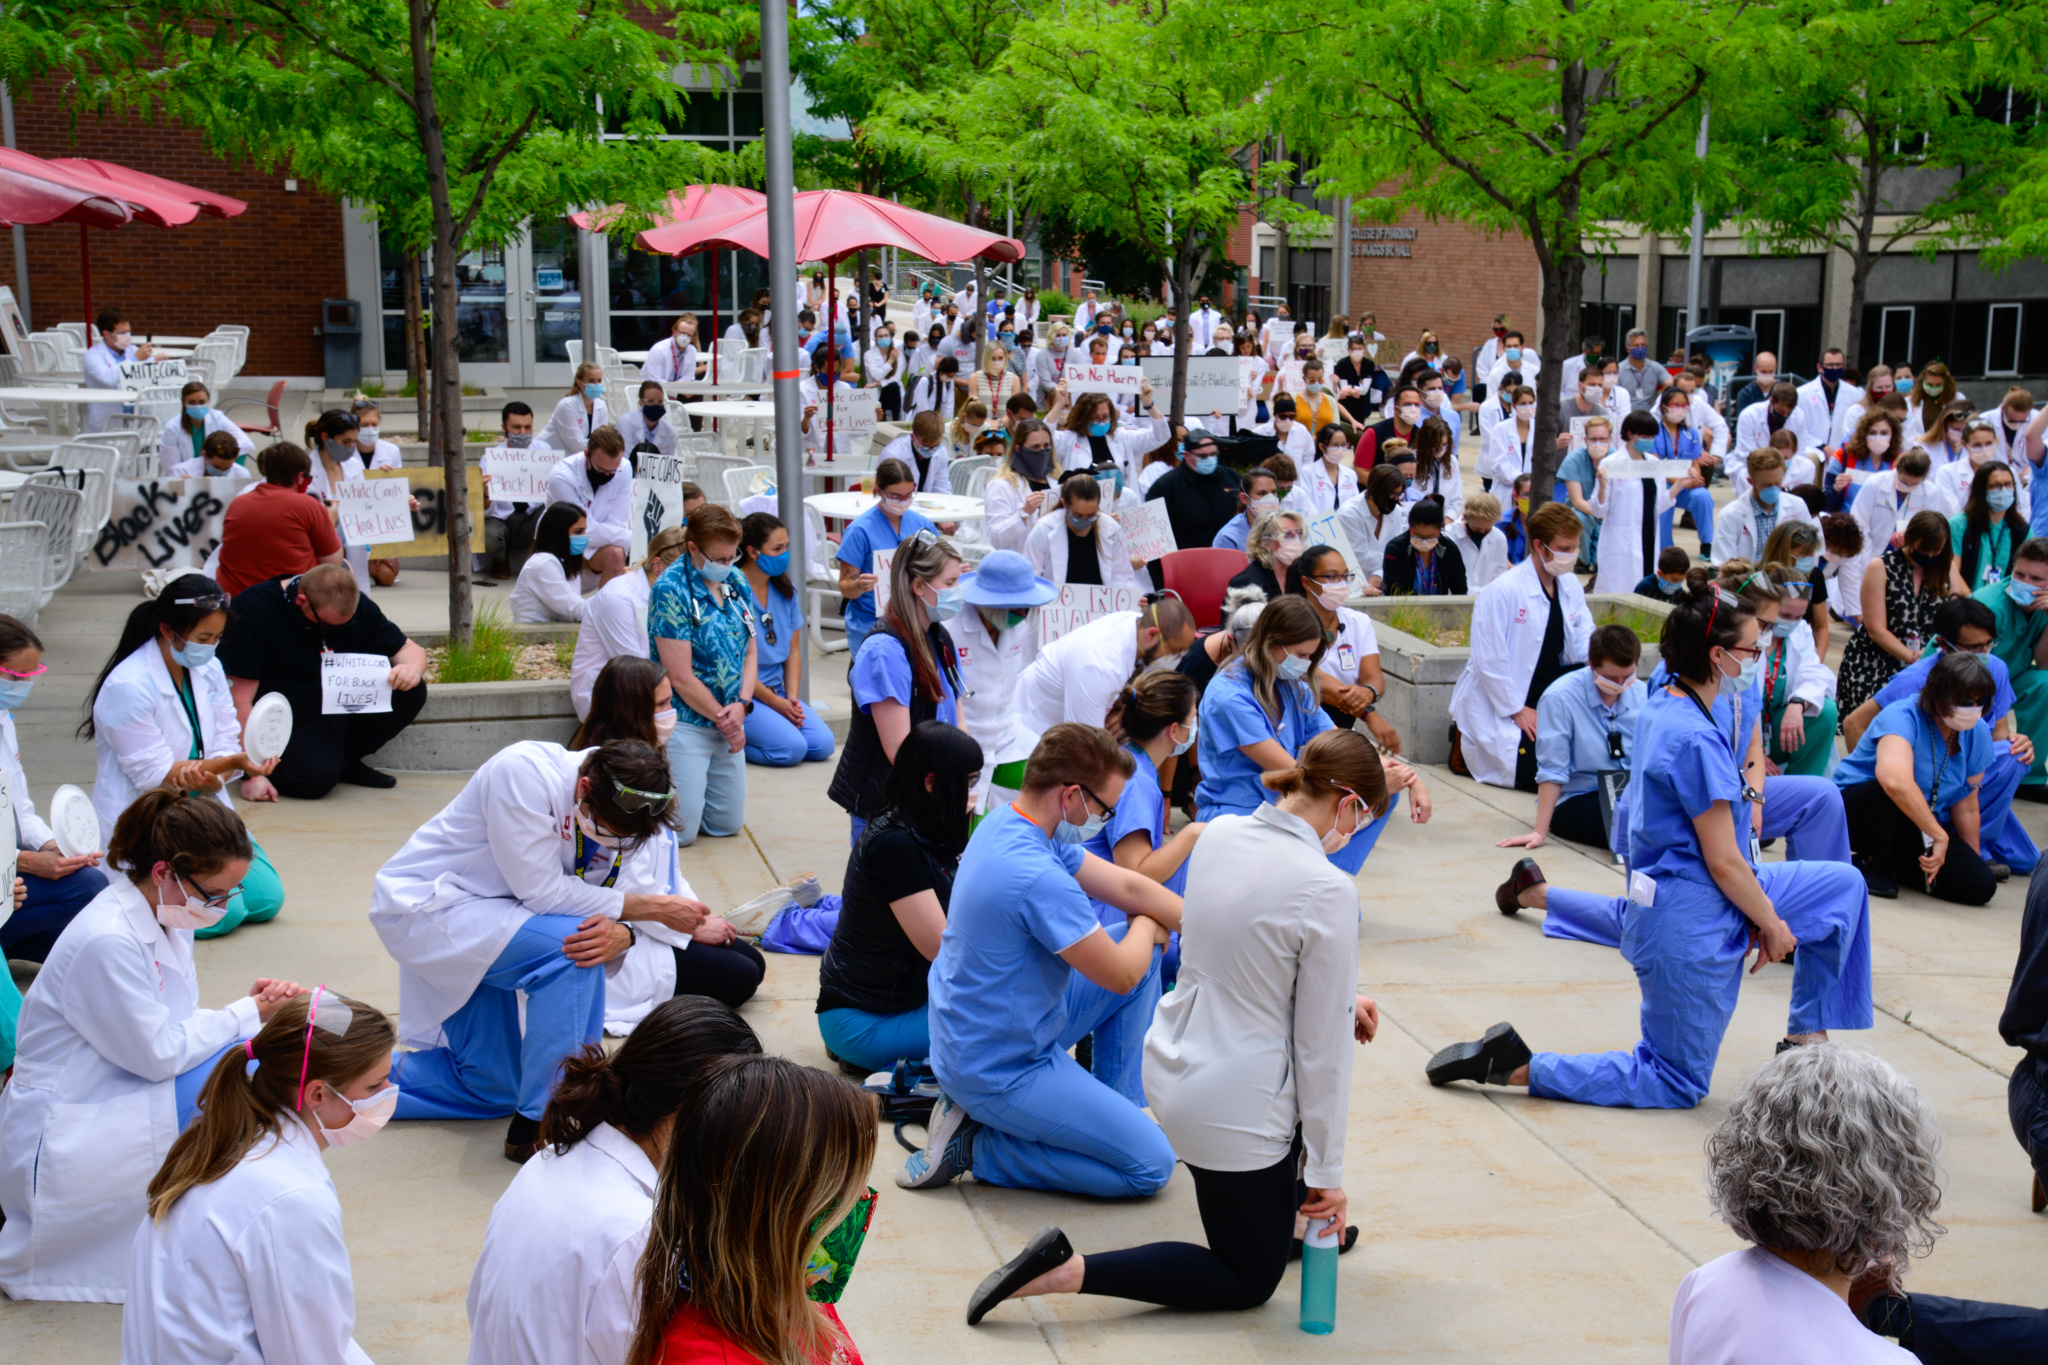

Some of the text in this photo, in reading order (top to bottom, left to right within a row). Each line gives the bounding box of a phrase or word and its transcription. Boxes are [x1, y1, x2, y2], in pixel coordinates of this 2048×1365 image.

[1069, 367, 1084, 381] Do
[1089, 368, 1103, 382] No
[1107, 369, 1137, 385] Harm
[836, 404, 849, 412] for
[849, 415, 874, 428] Lives
[490, 449, 527, 461] White
[337, 480, 402, 500] White Coats
[490, 474, 525, 493] Black
[365, 503, 373, 511] for
[94, 481, 178, 566] Black
[138, 491, 223, 568] Lives
[342, 511, 406, 540] Black Lives
[1090, 586, 1132, 613] NO
[328, 675, 377, 688] FOR BLACK
[337, 690, 378, 705] LIVES!
